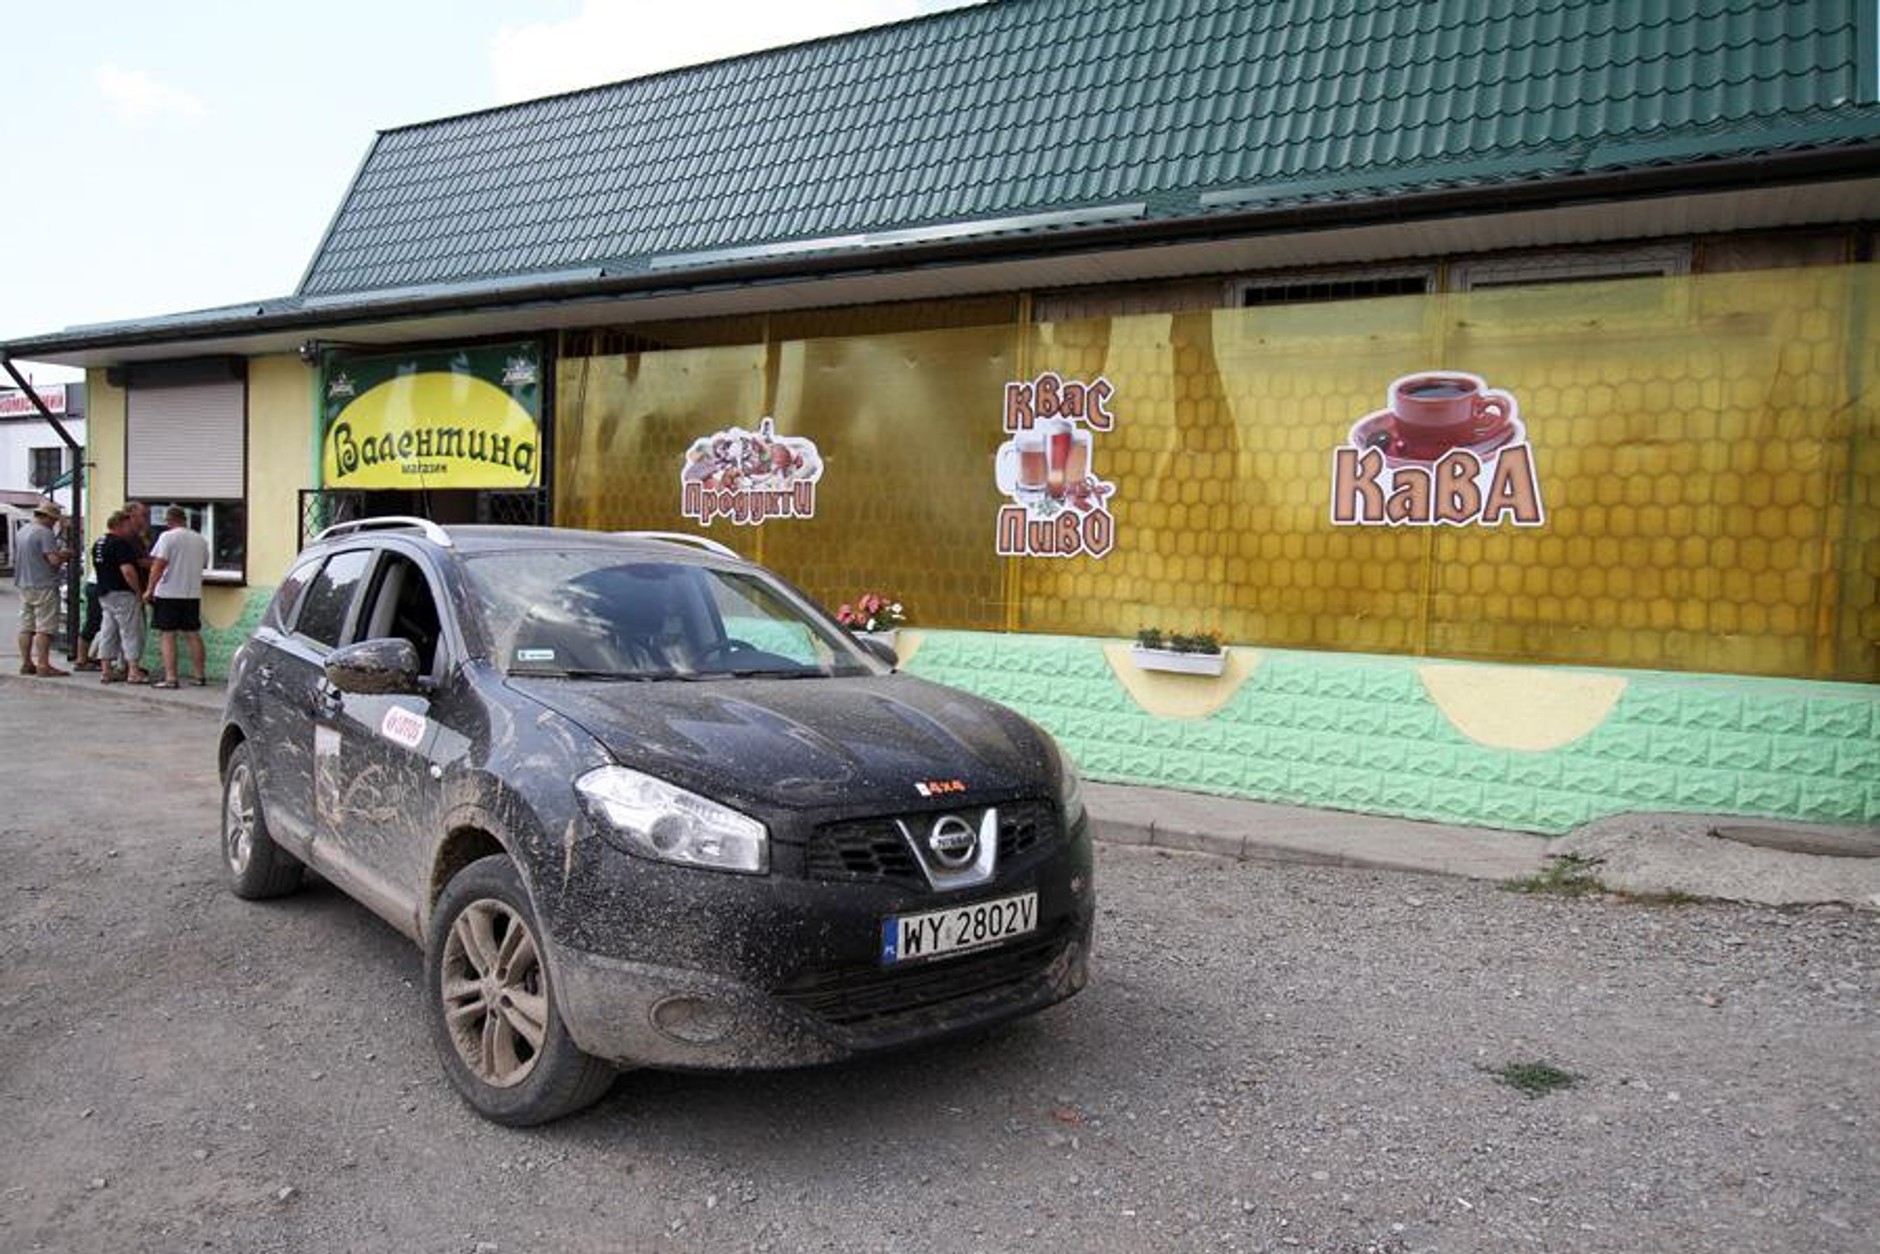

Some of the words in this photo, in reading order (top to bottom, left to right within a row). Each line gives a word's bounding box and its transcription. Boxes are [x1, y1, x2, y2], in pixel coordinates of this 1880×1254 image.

[333, 422, 536, 478] Валентина
[903, 915, 946, 955] WY
[956, 896, 1036, 946] 2802V
